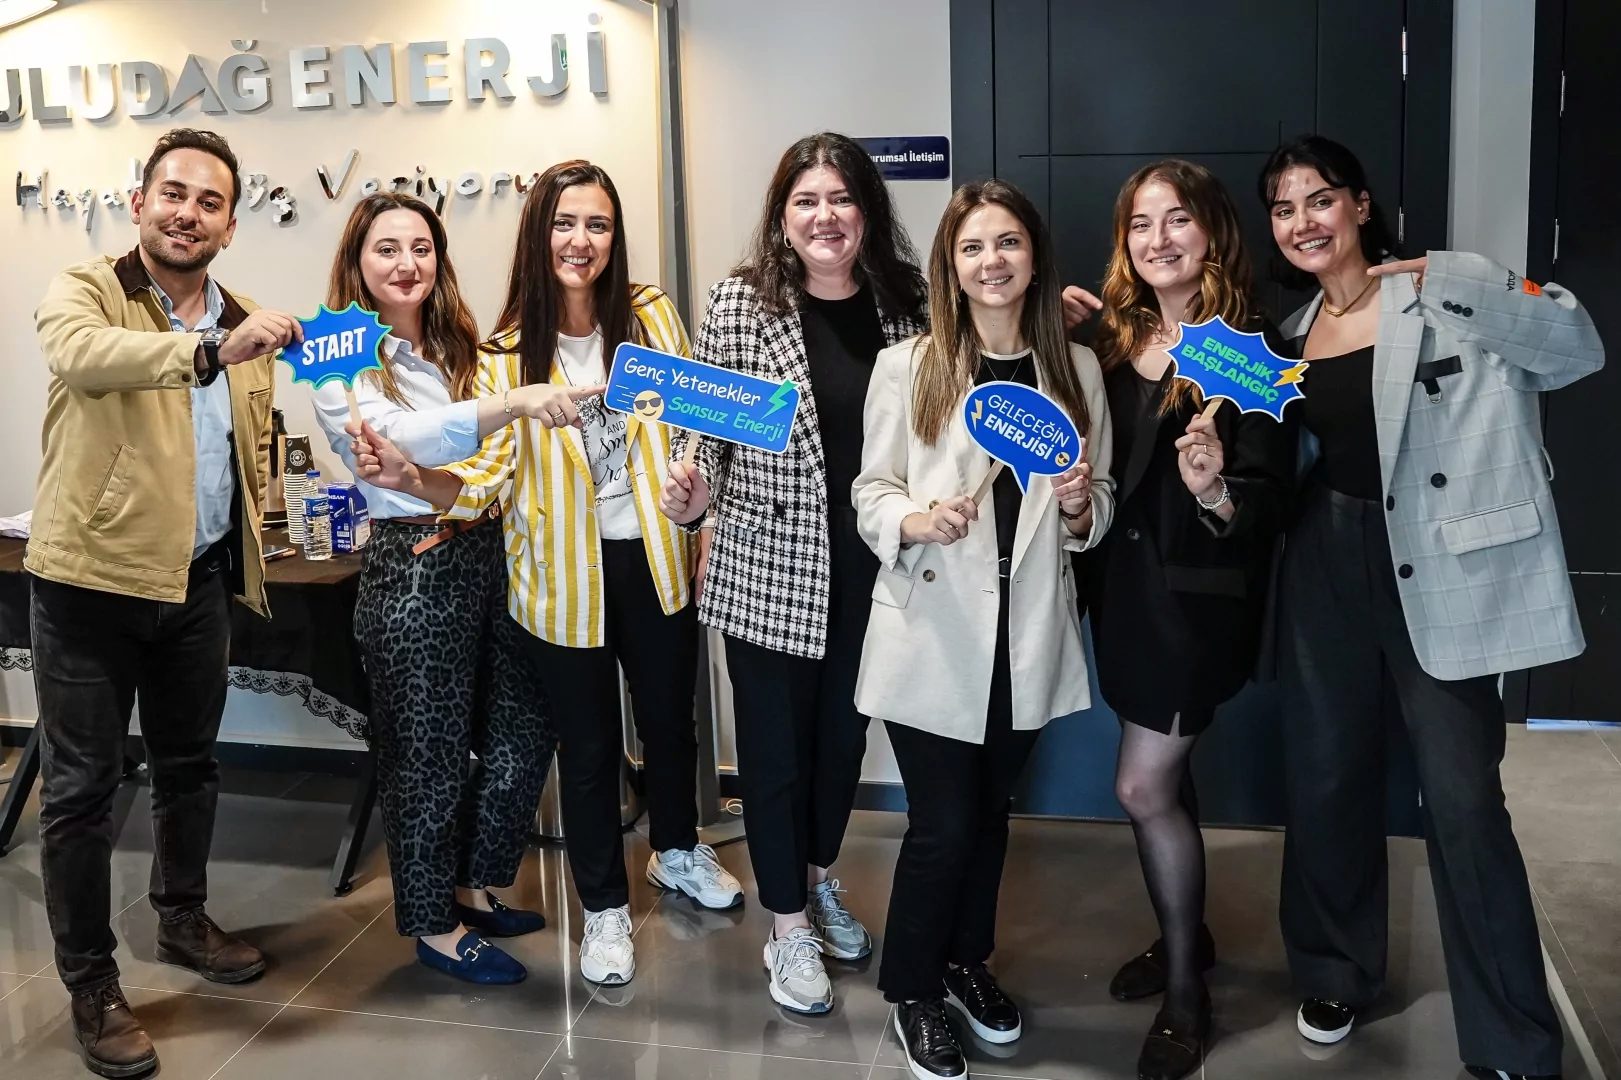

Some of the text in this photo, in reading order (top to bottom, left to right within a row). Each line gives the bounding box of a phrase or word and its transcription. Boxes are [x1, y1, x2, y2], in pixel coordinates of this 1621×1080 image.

[289, 12, 607, 108] ENERJİ
[869, 150, 945, 163] urumsal İletişim
[15, 157, 144, 231] Hayat
[316, 147, 540, 217] Veriyoru
[302, 326, 367, 366] START
[1201, 336, 1275, 382] ENERJİK
[624, 357, 761, 407] Genç Yetenekler
[1181, 343, 1279, 403] BAŞLANGIÇ
[607, 420, 626, 436] AND
[668, 396, 786, 442] Sonsuz Enerji
[983, 413, 1055, 460] ENERJİSİ
[988, 394, 1070, 448] GELECEĞİN
